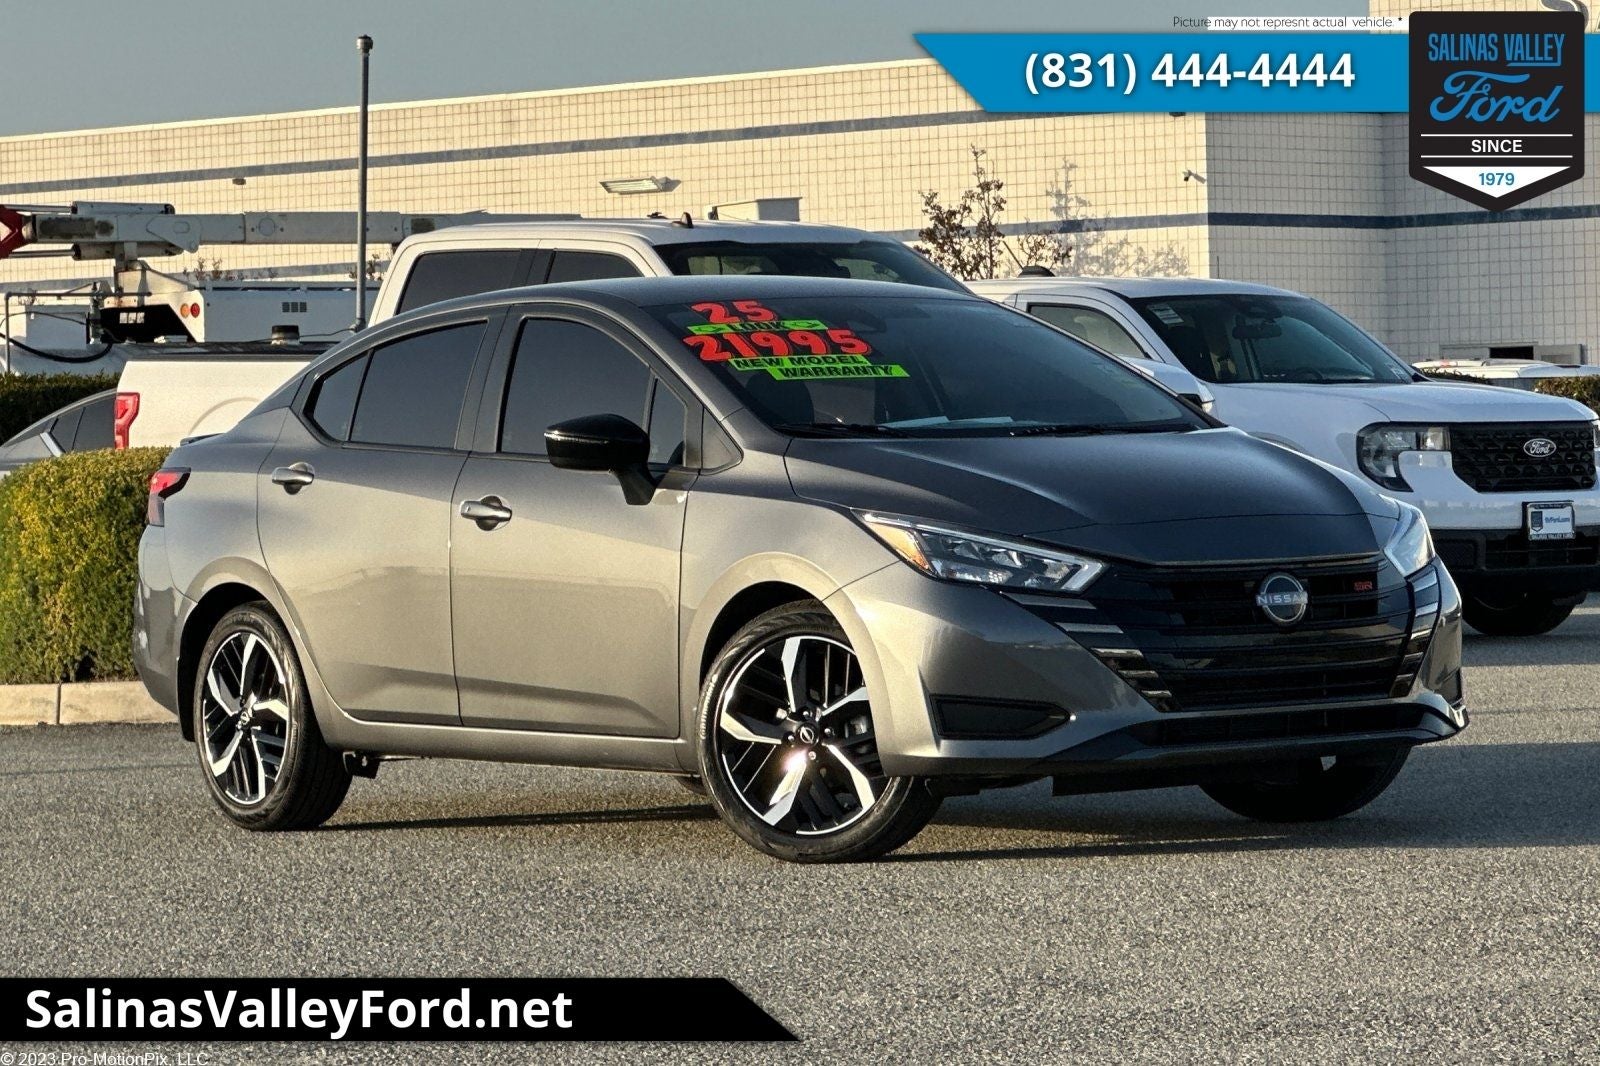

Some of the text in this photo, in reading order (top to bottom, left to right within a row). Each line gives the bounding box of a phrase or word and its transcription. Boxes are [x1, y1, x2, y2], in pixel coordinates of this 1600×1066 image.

[692, 300, 776, 324] 25
[684, 329, 870, 361] 21995
[734, 354, 864, 369] NEW MODEL
[779, 365, 893, 377] WARRANTY
[1530, 440, 1551, 454] Ford
